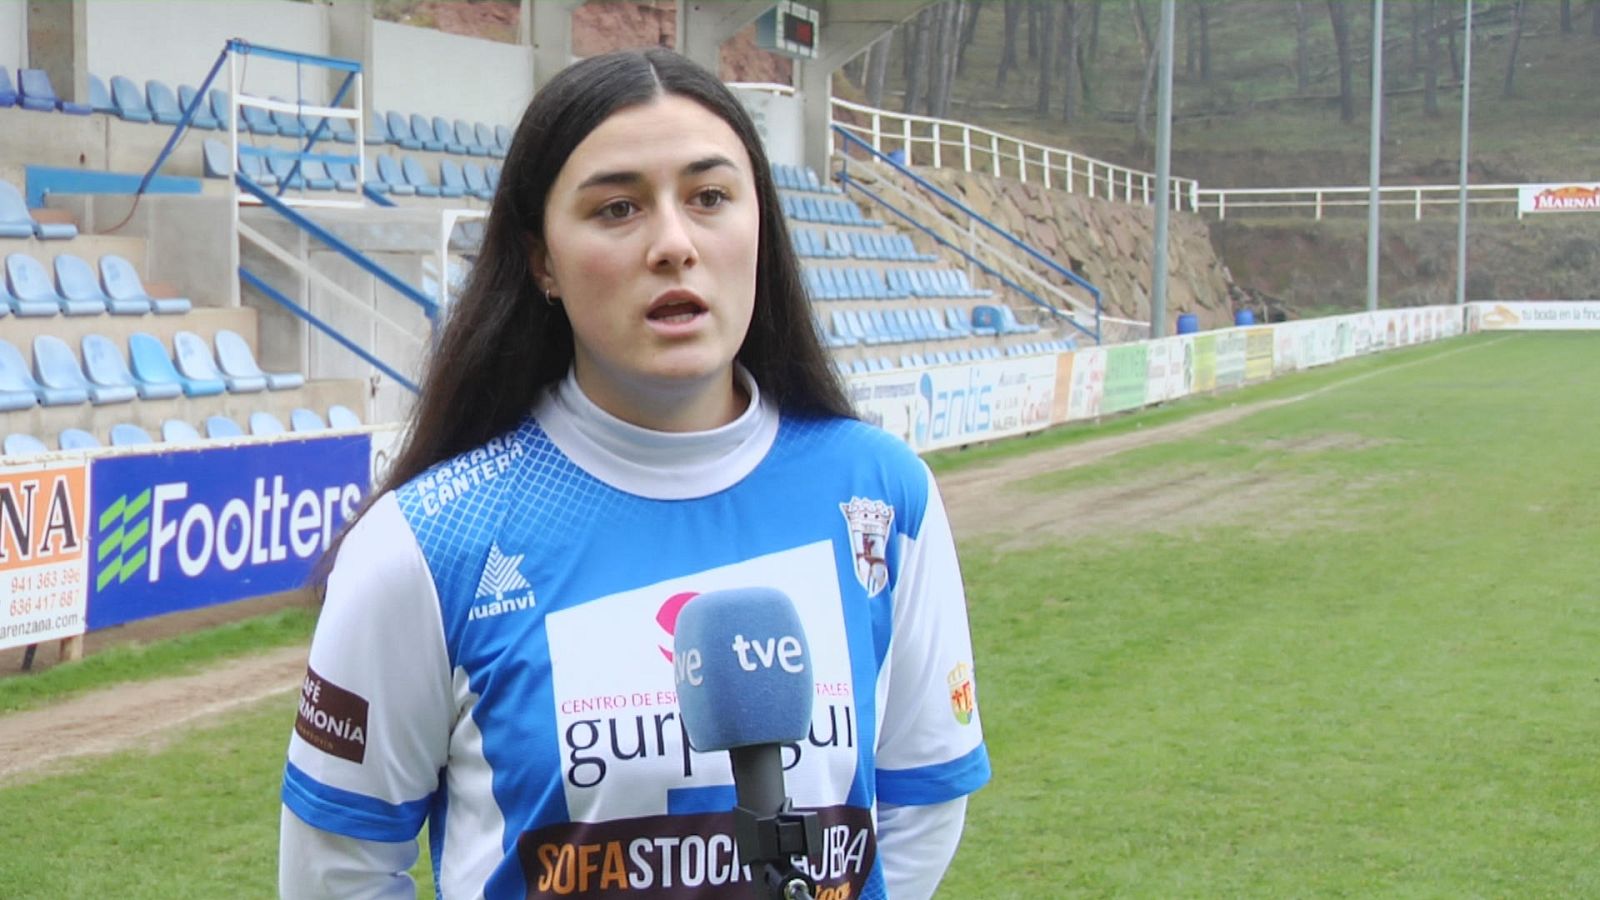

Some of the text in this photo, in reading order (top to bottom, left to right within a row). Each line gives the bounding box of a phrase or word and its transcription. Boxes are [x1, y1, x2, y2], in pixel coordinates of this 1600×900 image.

[422, 440, 524, 517] CANTERA
[147, 475, 362, 583] Footters
[11, 576, 31, 594] 941
[732, 634, 804, 673] tve
[561, 694, 627, 714] CENTRO
[631, 692, 652, 708] DE
